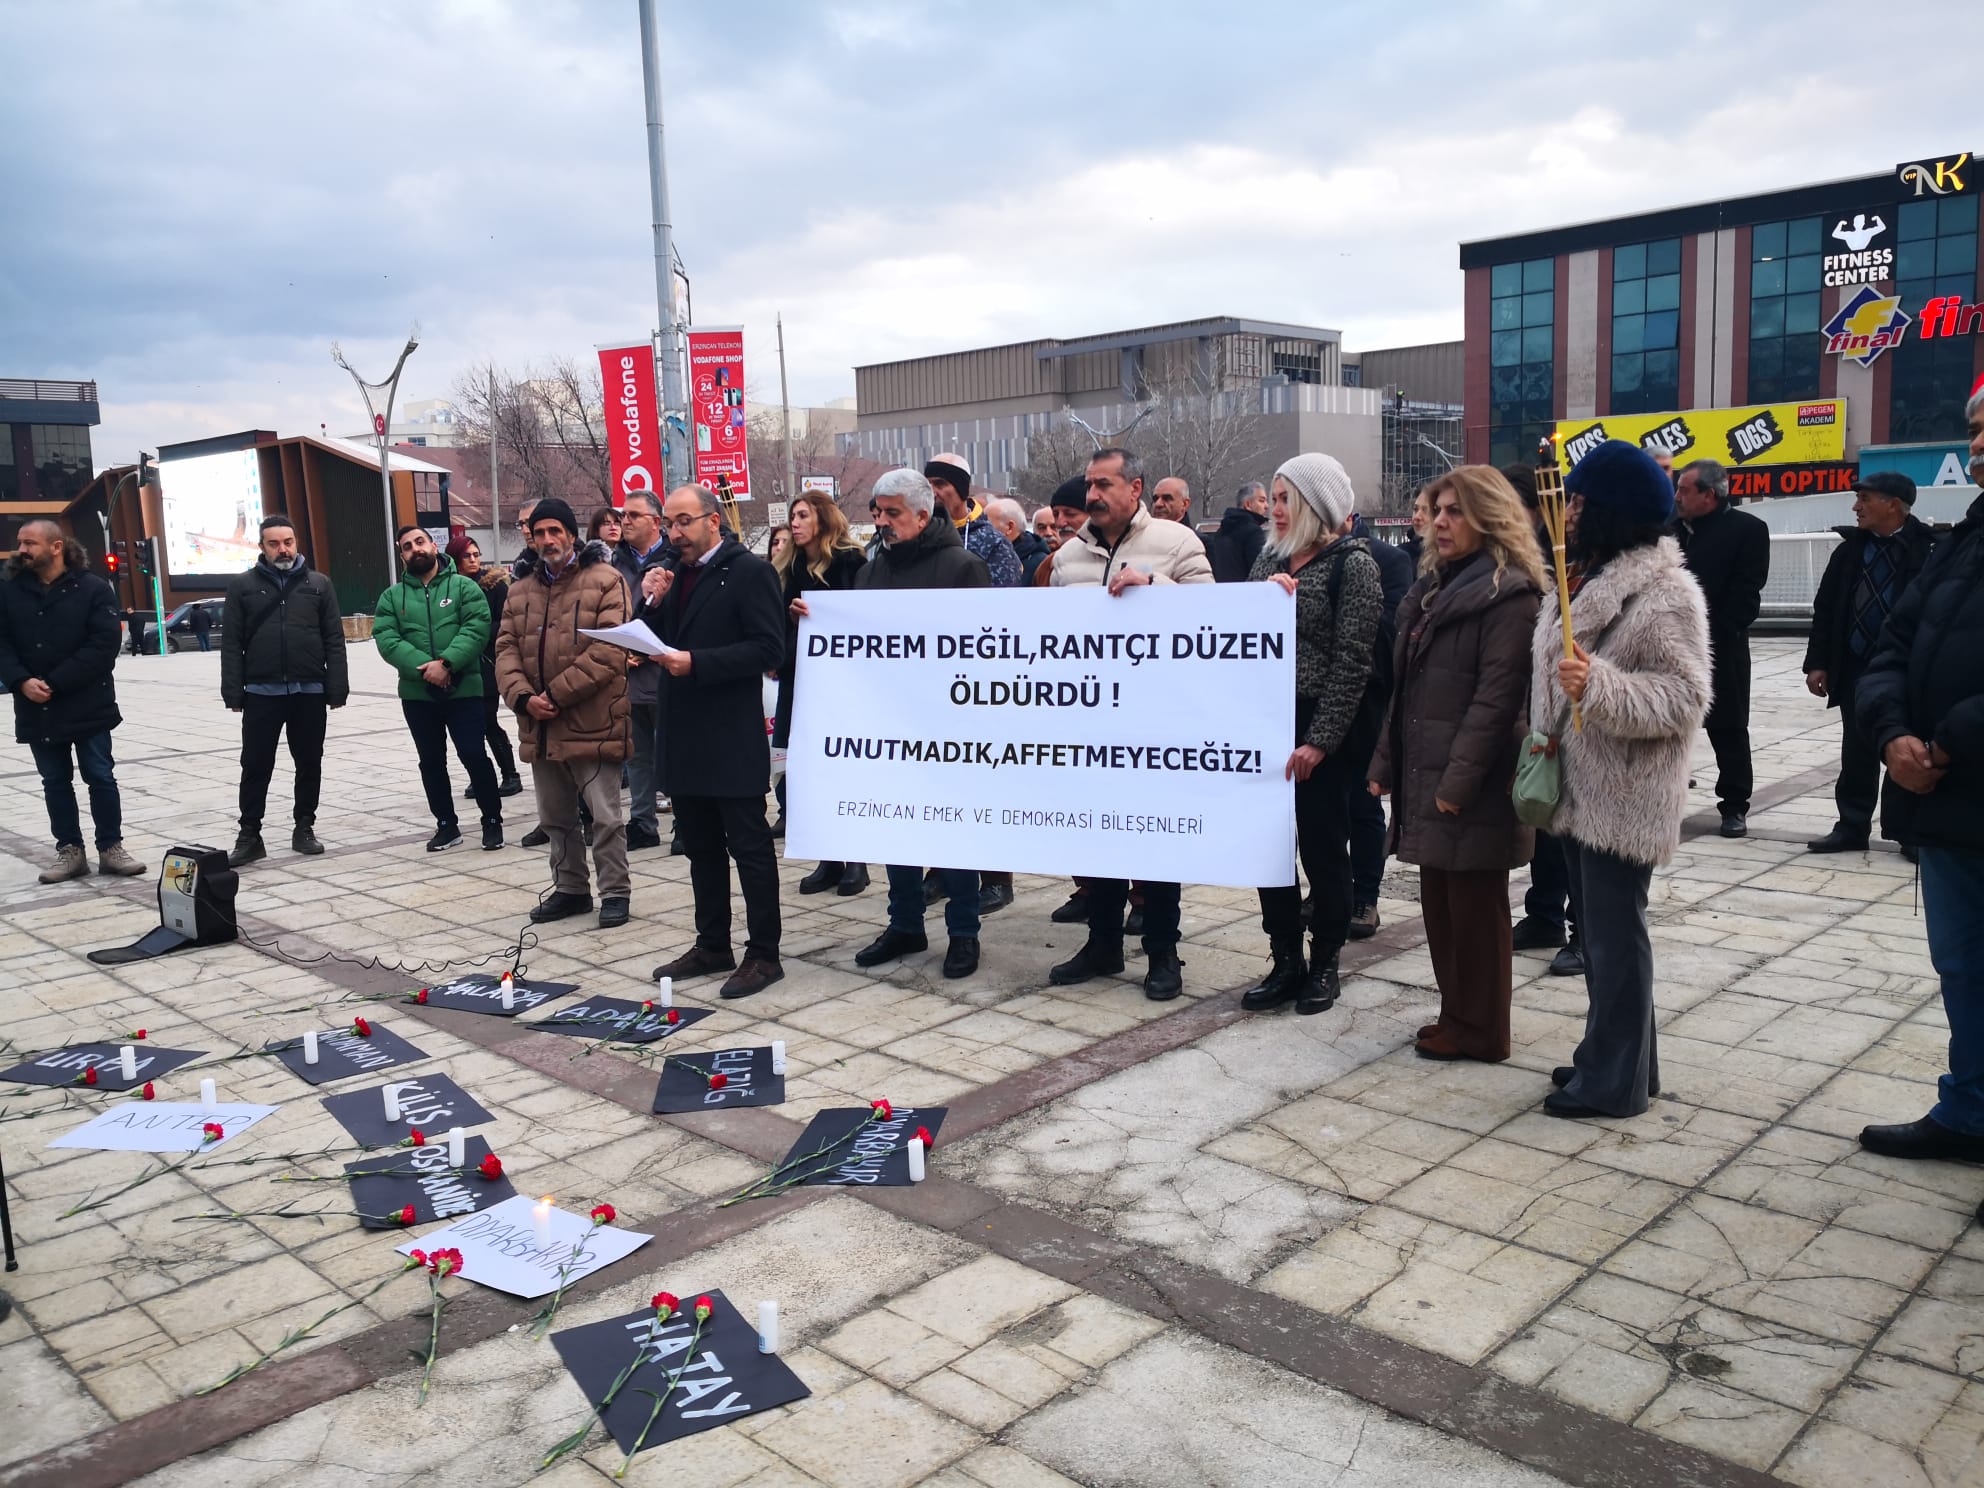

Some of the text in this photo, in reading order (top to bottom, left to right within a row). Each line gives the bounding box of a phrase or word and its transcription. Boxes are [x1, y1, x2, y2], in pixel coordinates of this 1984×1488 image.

[1824, 248, 1893, 271] FITNESS
[1824, 265, 1889, 287] CENTER
[1829, 327, 1901, 351] final
[693, 356, 725, 364] VODAFONE
[701, 383, 712, 391] 24
[620, 356, 642, 460] vodafone
[708, 403, 723, 414] 12
[1800, 415, 1834, 425] AKADEMİ
[1809, 405, 1834, 414] PEGEM
[725, 425, 733, 437] 6
[1734, 418, 1773, 456] DGS
[1780, 468, 1853, 493] OPTİK
[807, 626, 1284, 666] DEPREM DEĞİL,RANTÇI DÜZEN
[950, 674, 1101, 707] ÖLDÜRDÜ
[824, 737, 1262, 774] UNUTMADIK,AFFETMEYECEĞİZ!
[837, 799, 1203, 835] ERZİNCAN EMEK VE DEMOKRASİ BİLEŞENLERİ
[625, 1311, 751, 1419] HATAY
